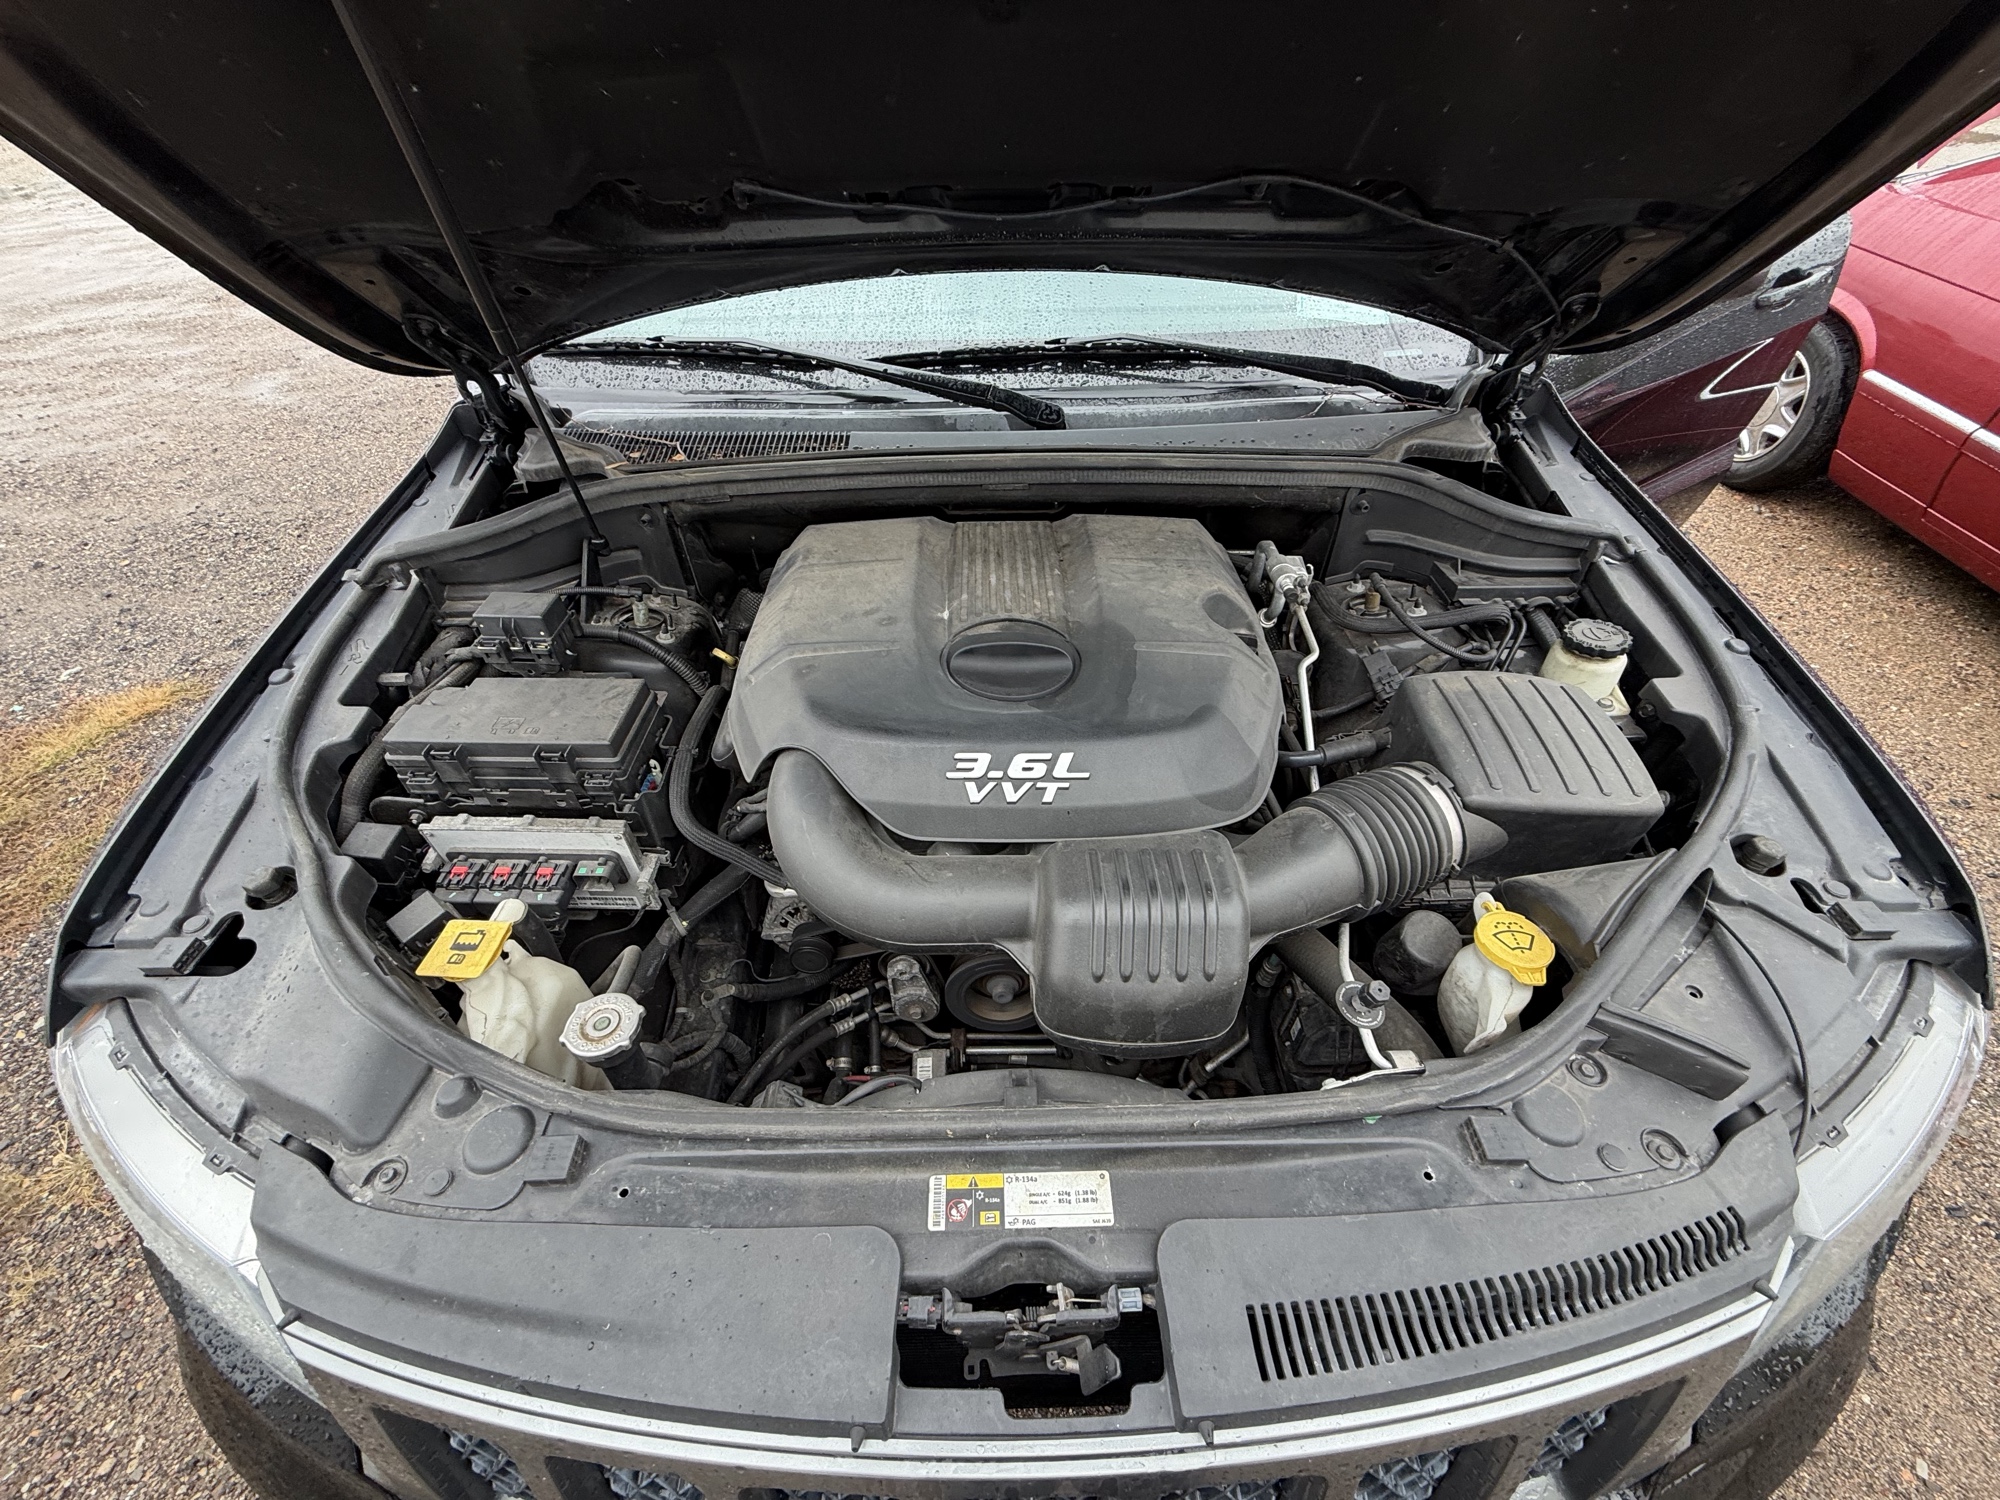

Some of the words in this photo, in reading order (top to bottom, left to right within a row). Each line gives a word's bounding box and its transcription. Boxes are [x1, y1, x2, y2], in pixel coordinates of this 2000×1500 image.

[945, 752, 1091, 779] 3.6L
[964, 781, 1070, 804] VVT
[592, 996, 619, 1008] KEEP
[609, 1030, 625, 1045] HOT
[1014, 1175, 1038, 1183] R-134a
[1074, 1189, 1089, 1197] (1.38
[1090, 1196, 1099, 1204] lb)
[1021, 1218, 1036, 1226] PAG
